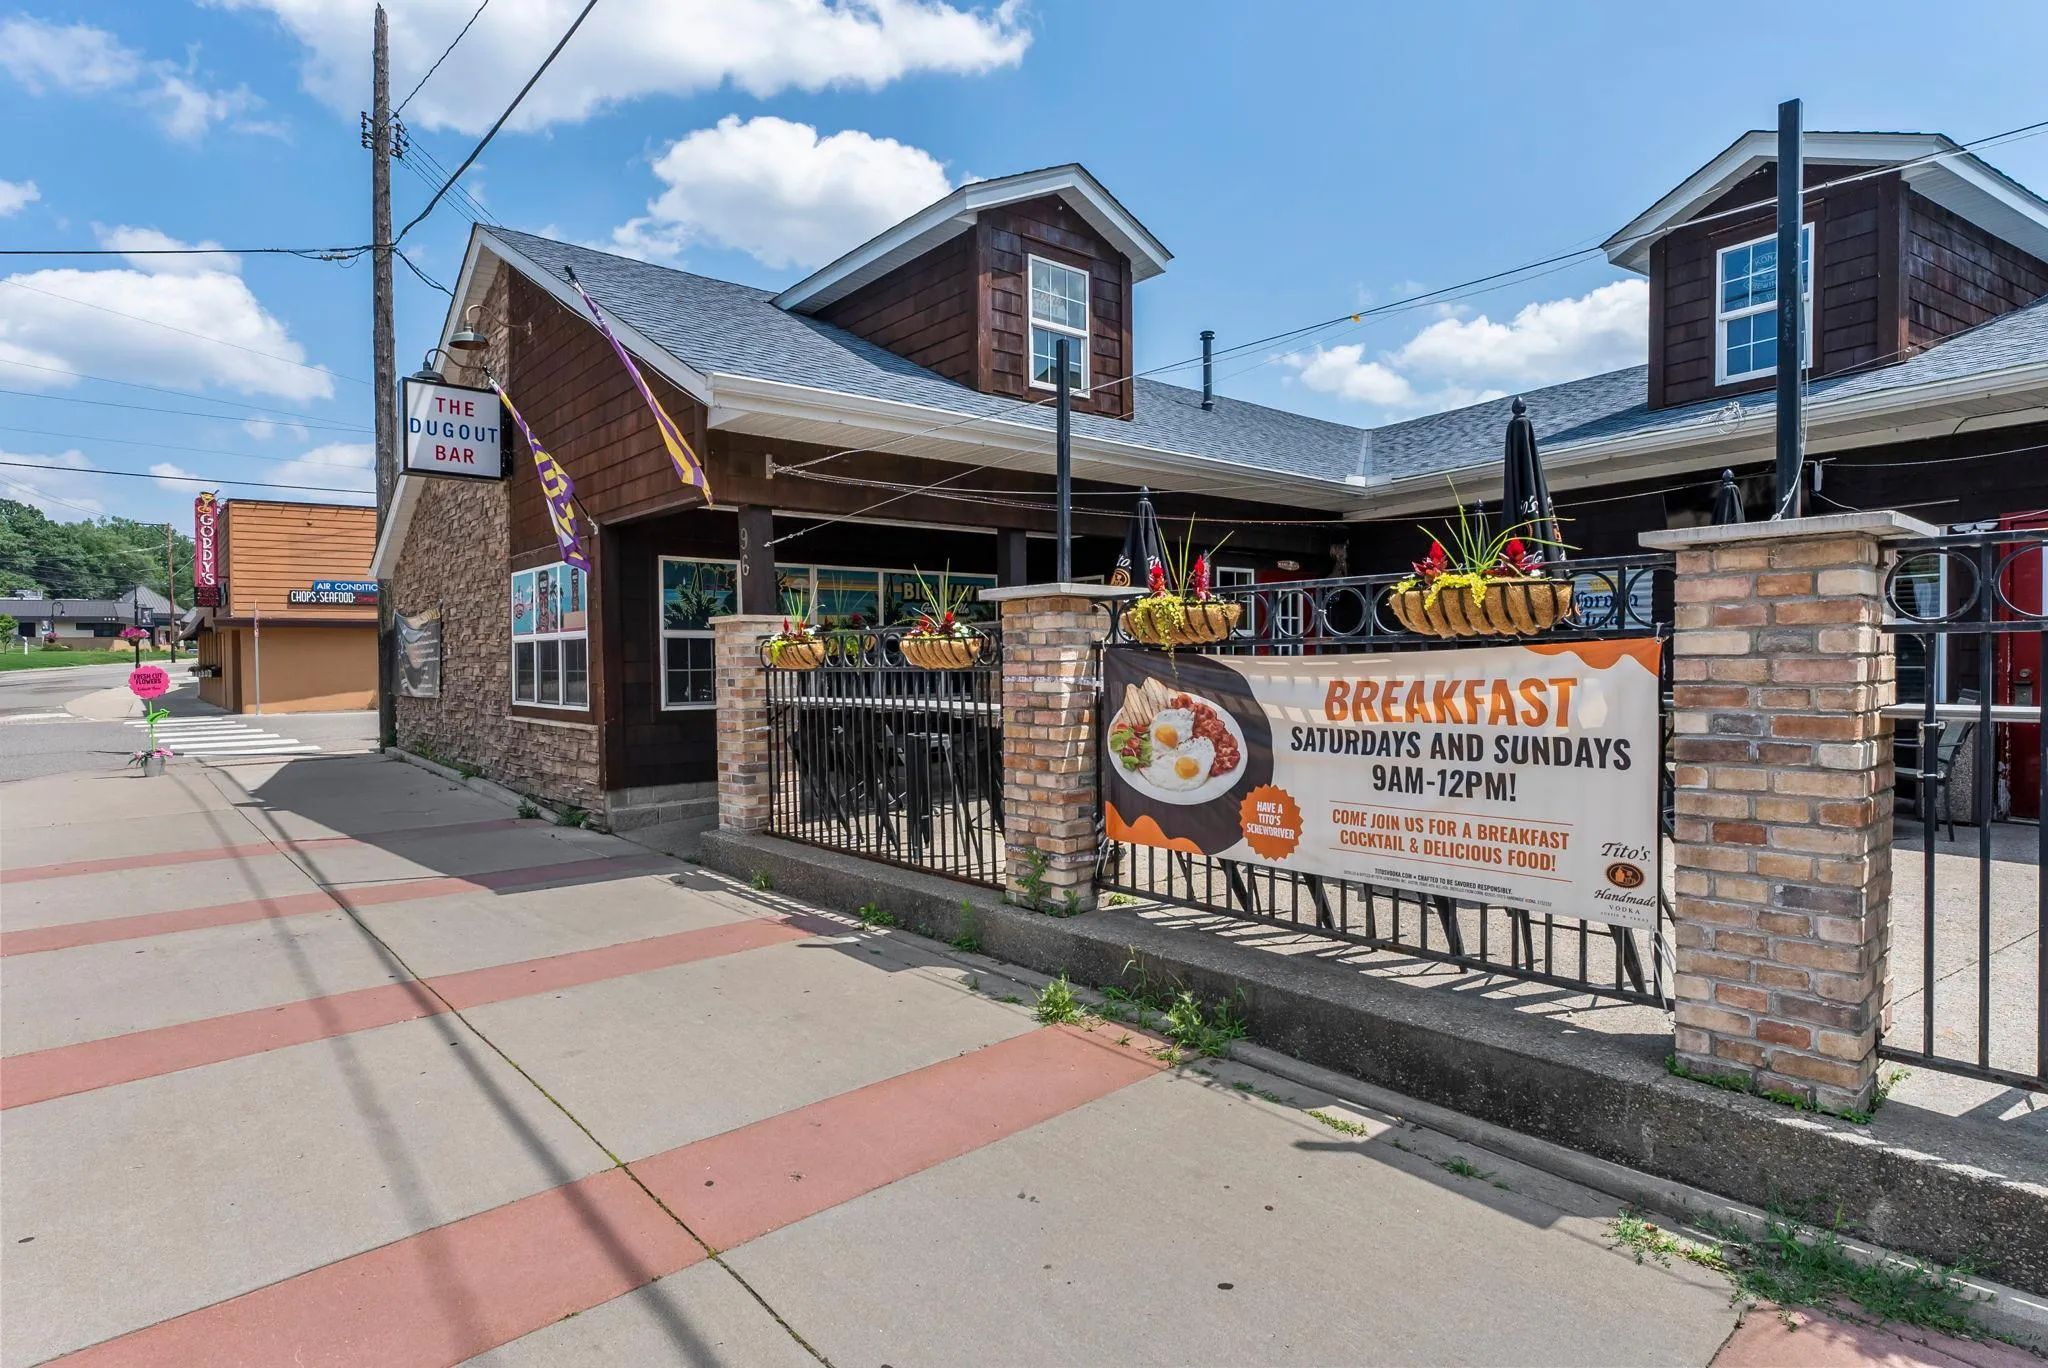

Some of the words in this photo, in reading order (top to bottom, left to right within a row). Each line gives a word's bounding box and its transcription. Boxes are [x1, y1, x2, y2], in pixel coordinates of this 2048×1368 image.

[435, 397, 475, 417] THE
[410, 417, 498, 443] DUGOUT
[435, 445, 475, 464] BAR
[200, 514, 215, 585] GORDY'S
[316, 582, 331, 590] AIR
[903, 582, 931, 600] BIG
[1575, 590, 1640, 612] Coroa
[1324, 677, 1577, 728] BREAKFAST
[1290, 726, 1421, 759] SATURDAYS
[1430, 732, 1484, 762] AND
[1493, 734, 1632, 771] SUNDAYS
[1372, 764, 1516, 802] 9AM-12PM!
[1256, 801, 1277, 814] HAVE
[1277, 803, 1284, 814] A
[1257, 813, 1281, 826] TITO'S
[1332, 808, 1368, 827] COME
[1370, 813, 1400, 830] JOIN
[1404, 816, 1424, 833] US
[1428, 818, 1457, 837] FOR
[1462, 822, 1472, 839] A
[1477, 823, 1570, 850] BREAKFAST
[1246, 822, 1295, 840] SCREWDRIVER
[1340, 829, 1405, 852] COCKTAIL
[1409, 837, 1419, 854] &
[1423, 839, 1503, 865] DELICIOUS
[1508, 849, 1556, 872] FOOD!
[1601, 842, 1651, 861] Tito's
[1417, 874, 1439, 884] CRAFTED
[1439, 877, 1447, 885] TO
[1454, 880, 1477, 889] SAVORED
[1593, 888, 1656, 908] Handmade
[1609, 904, 1641, 915] VODKA
